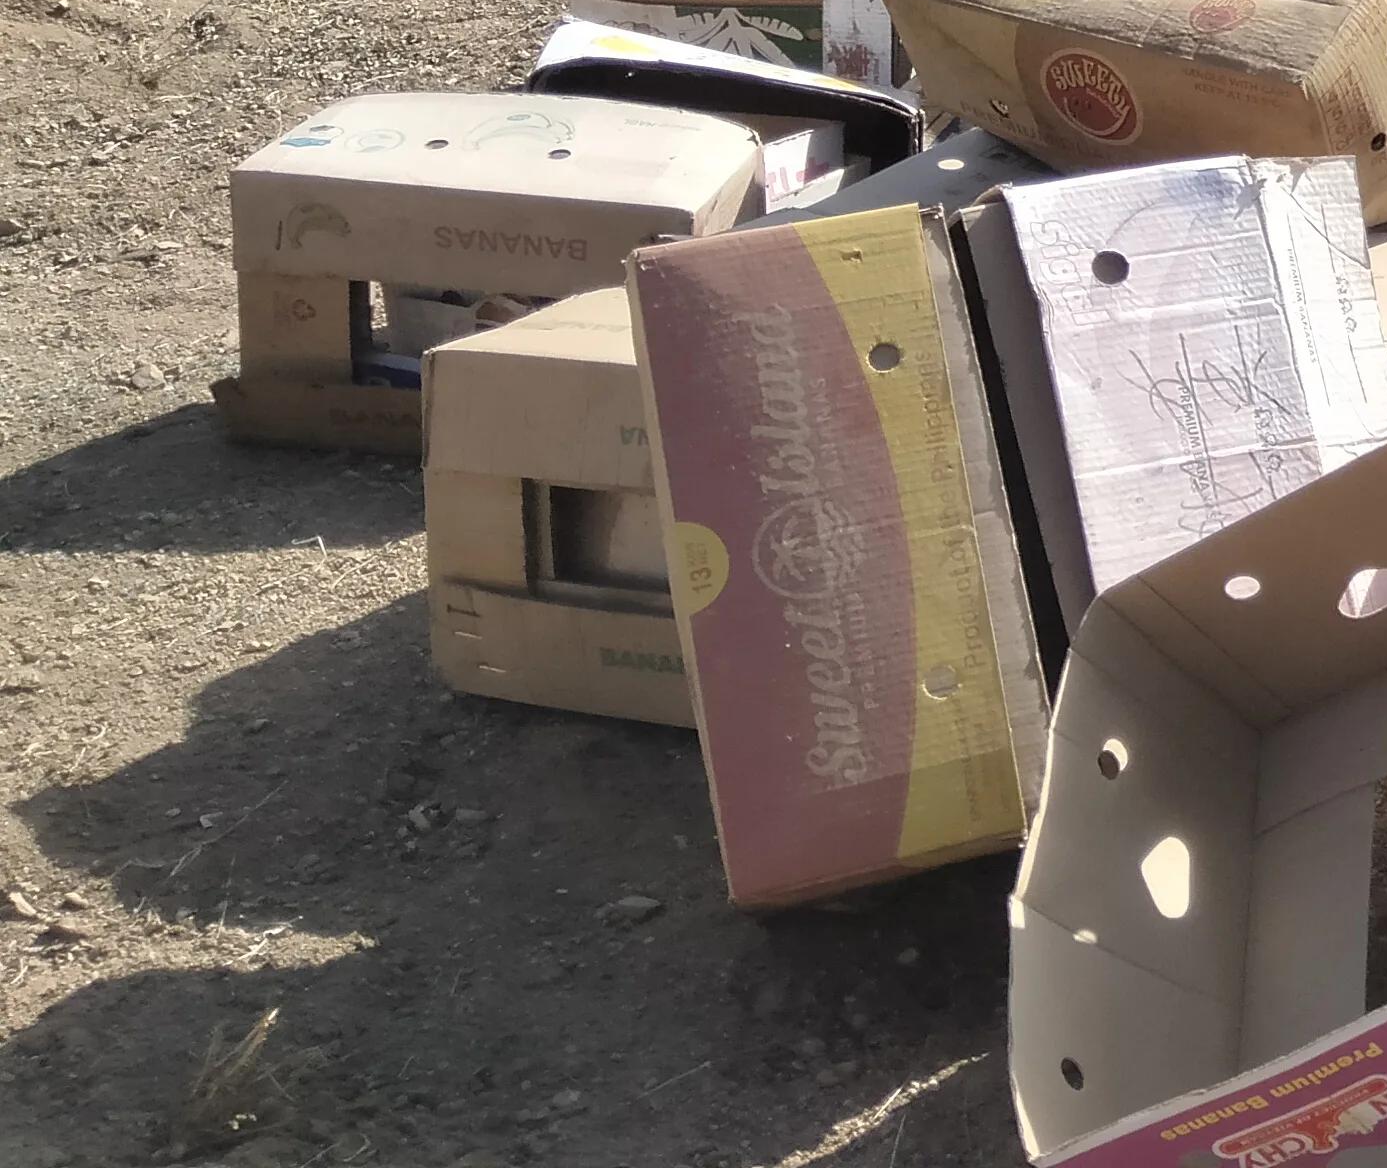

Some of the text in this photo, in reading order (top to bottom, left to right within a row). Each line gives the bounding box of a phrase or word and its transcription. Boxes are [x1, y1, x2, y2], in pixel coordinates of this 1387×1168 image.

[1051, 58, 1131, 122] SWEETY
[434, 224, 588, 262] BANANAS
[1178, 385, 1201, 449] PREMIUM
[691, 562, 713, 595] 13
[1160, 1041, 1384, 1142] Premium Bananas
